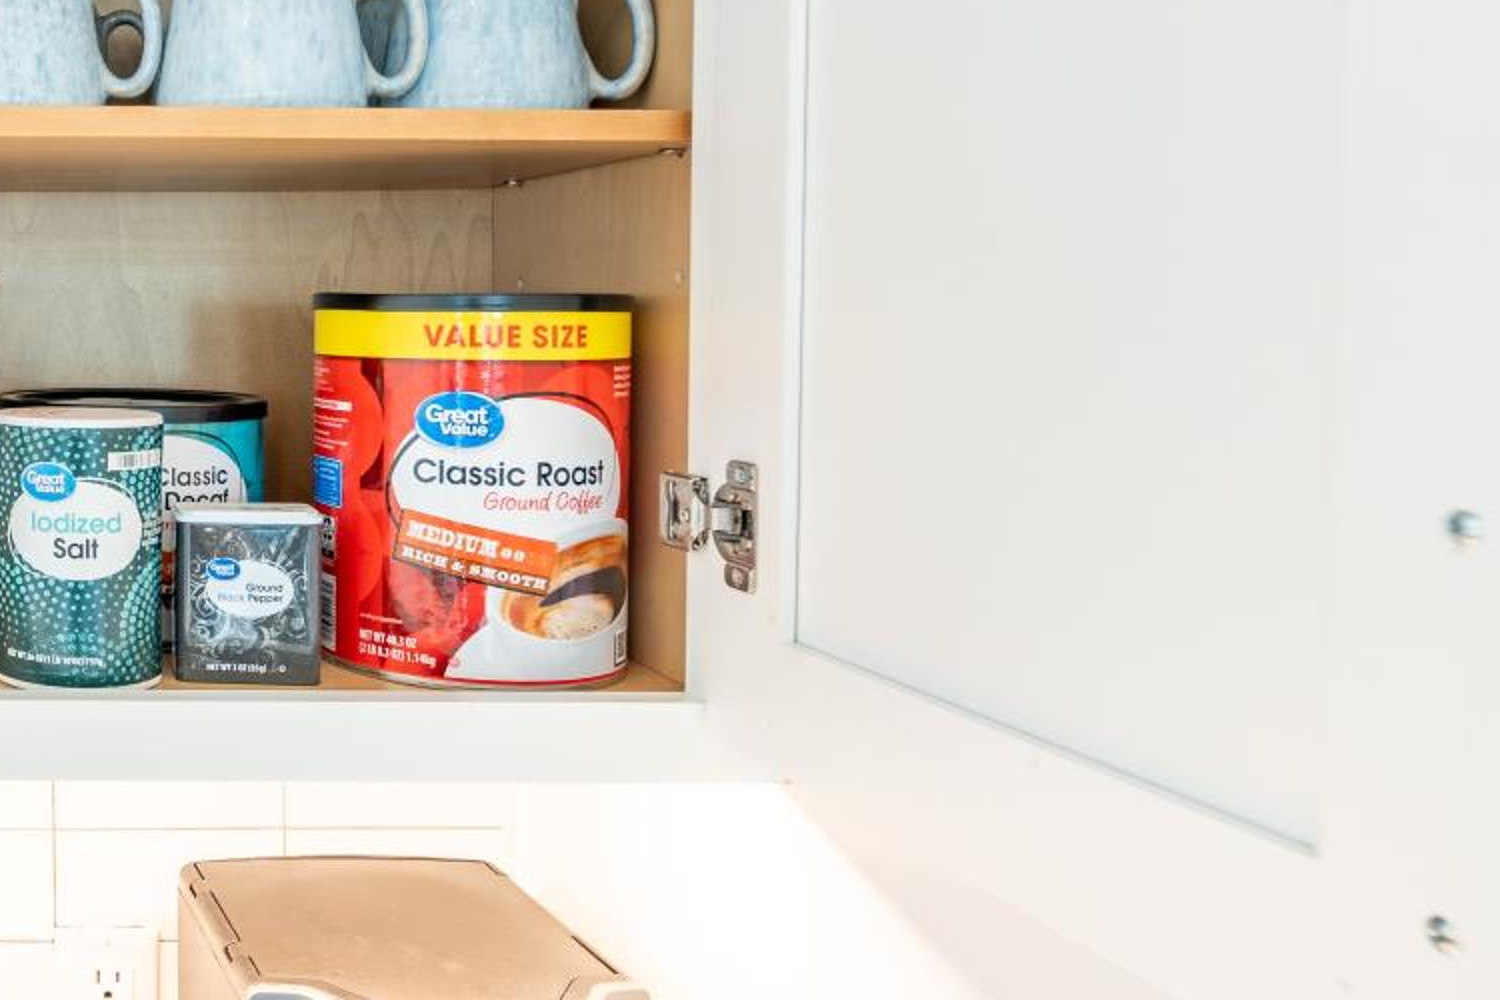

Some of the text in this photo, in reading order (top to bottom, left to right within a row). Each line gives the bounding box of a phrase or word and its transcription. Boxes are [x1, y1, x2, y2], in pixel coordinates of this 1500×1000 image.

[424, 324, 588, 348] VALUE SIZE
[426, 404, 489, 425] Great
[440, 421, 489, 437] Value
[413, 458, 604, 487] Classic Roast
[484, 489, 604, 514] Ground Coffee
[31, 512, 122, 534] Iodized
[53, 538, 99, 559] Salt
[406, 520, 499, 559] MEDIUM
[402, 545, 449, 569] RICH
[468, 564, 549, 590] SMOOTH
